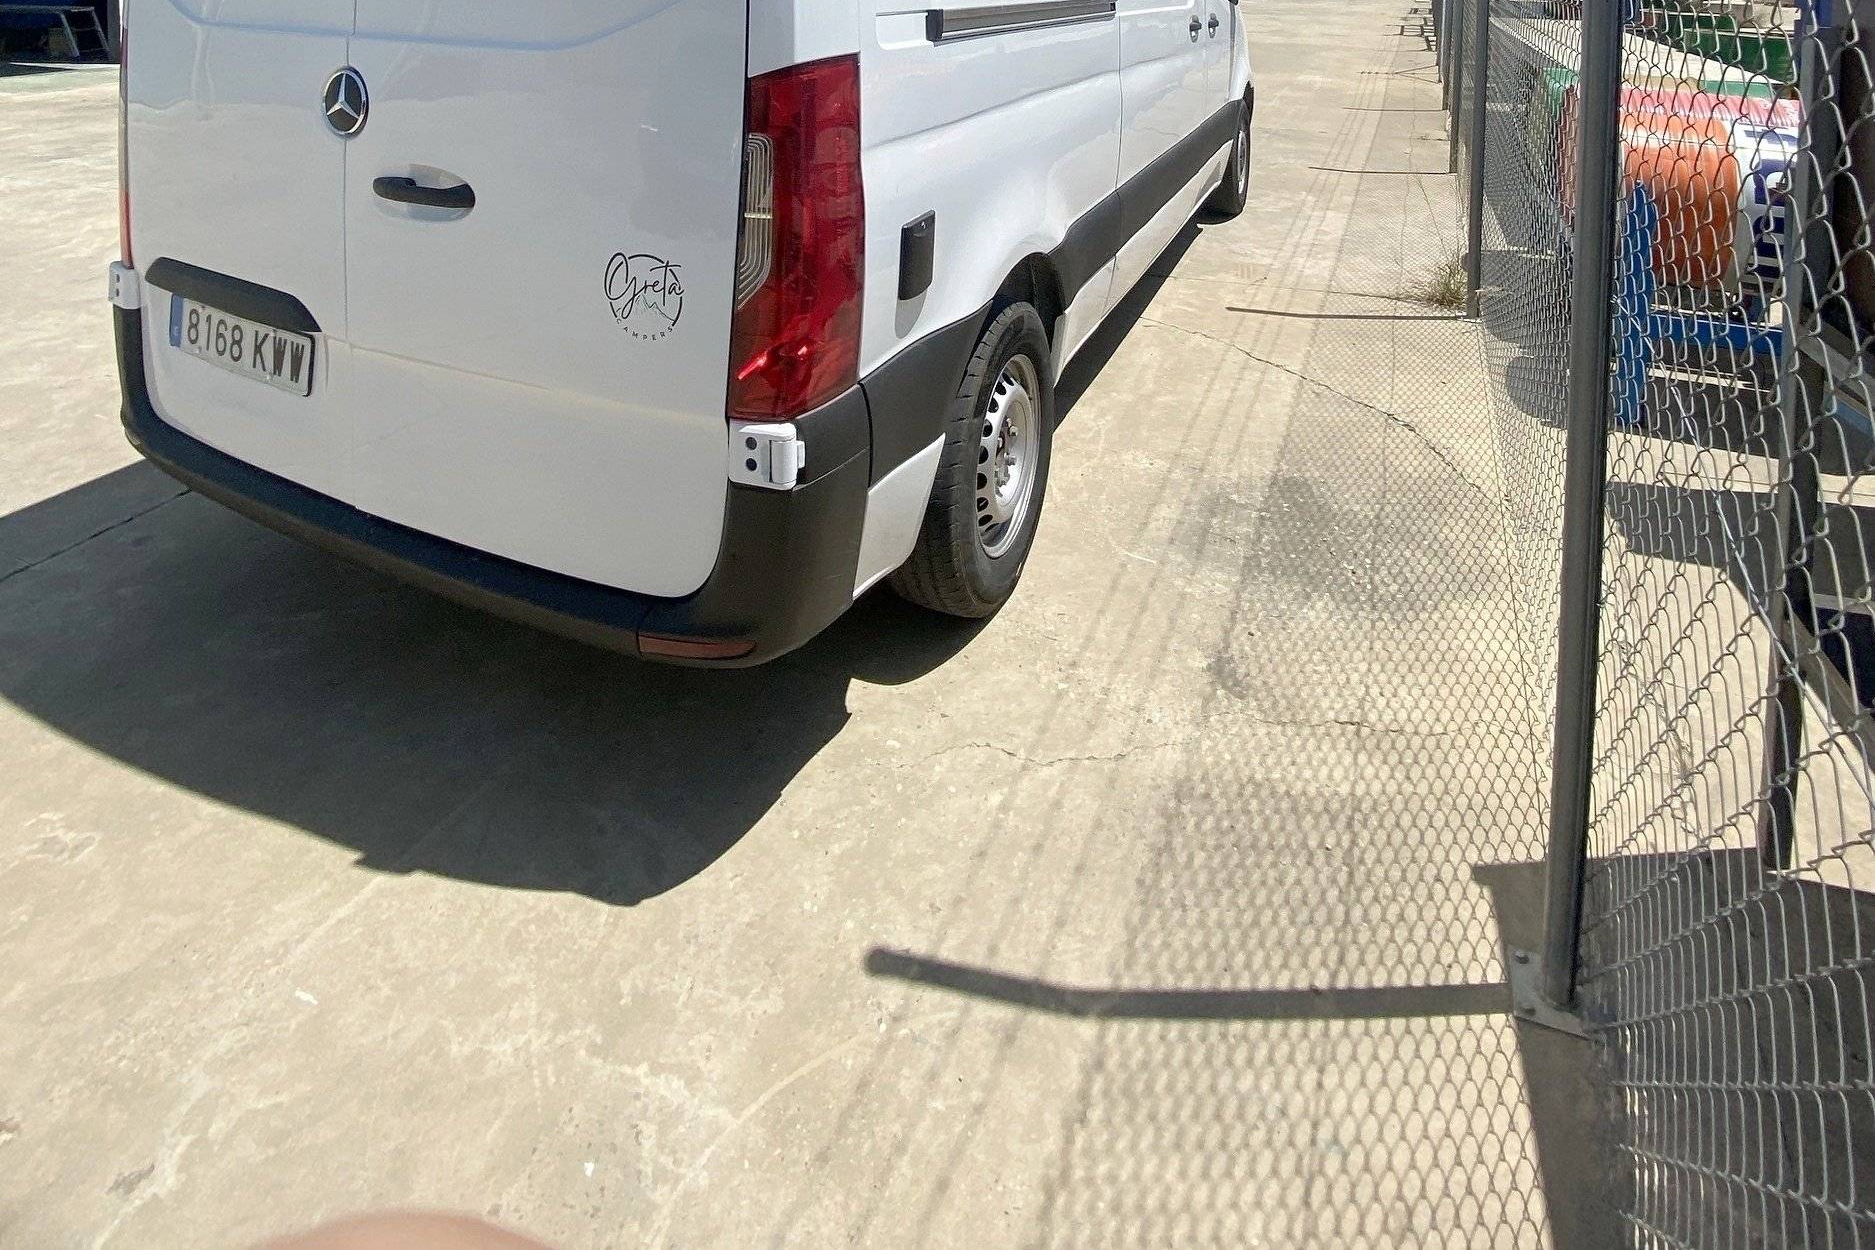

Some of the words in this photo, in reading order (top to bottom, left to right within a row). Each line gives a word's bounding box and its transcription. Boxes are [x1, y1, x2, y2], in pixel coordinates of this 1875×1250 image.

[604, 252, 685, 319] Greta
[187, 308, 244, 363] 8168
[252, 329, 305, 384] KWW
[616, 318, 673, 341] CAMPERS
